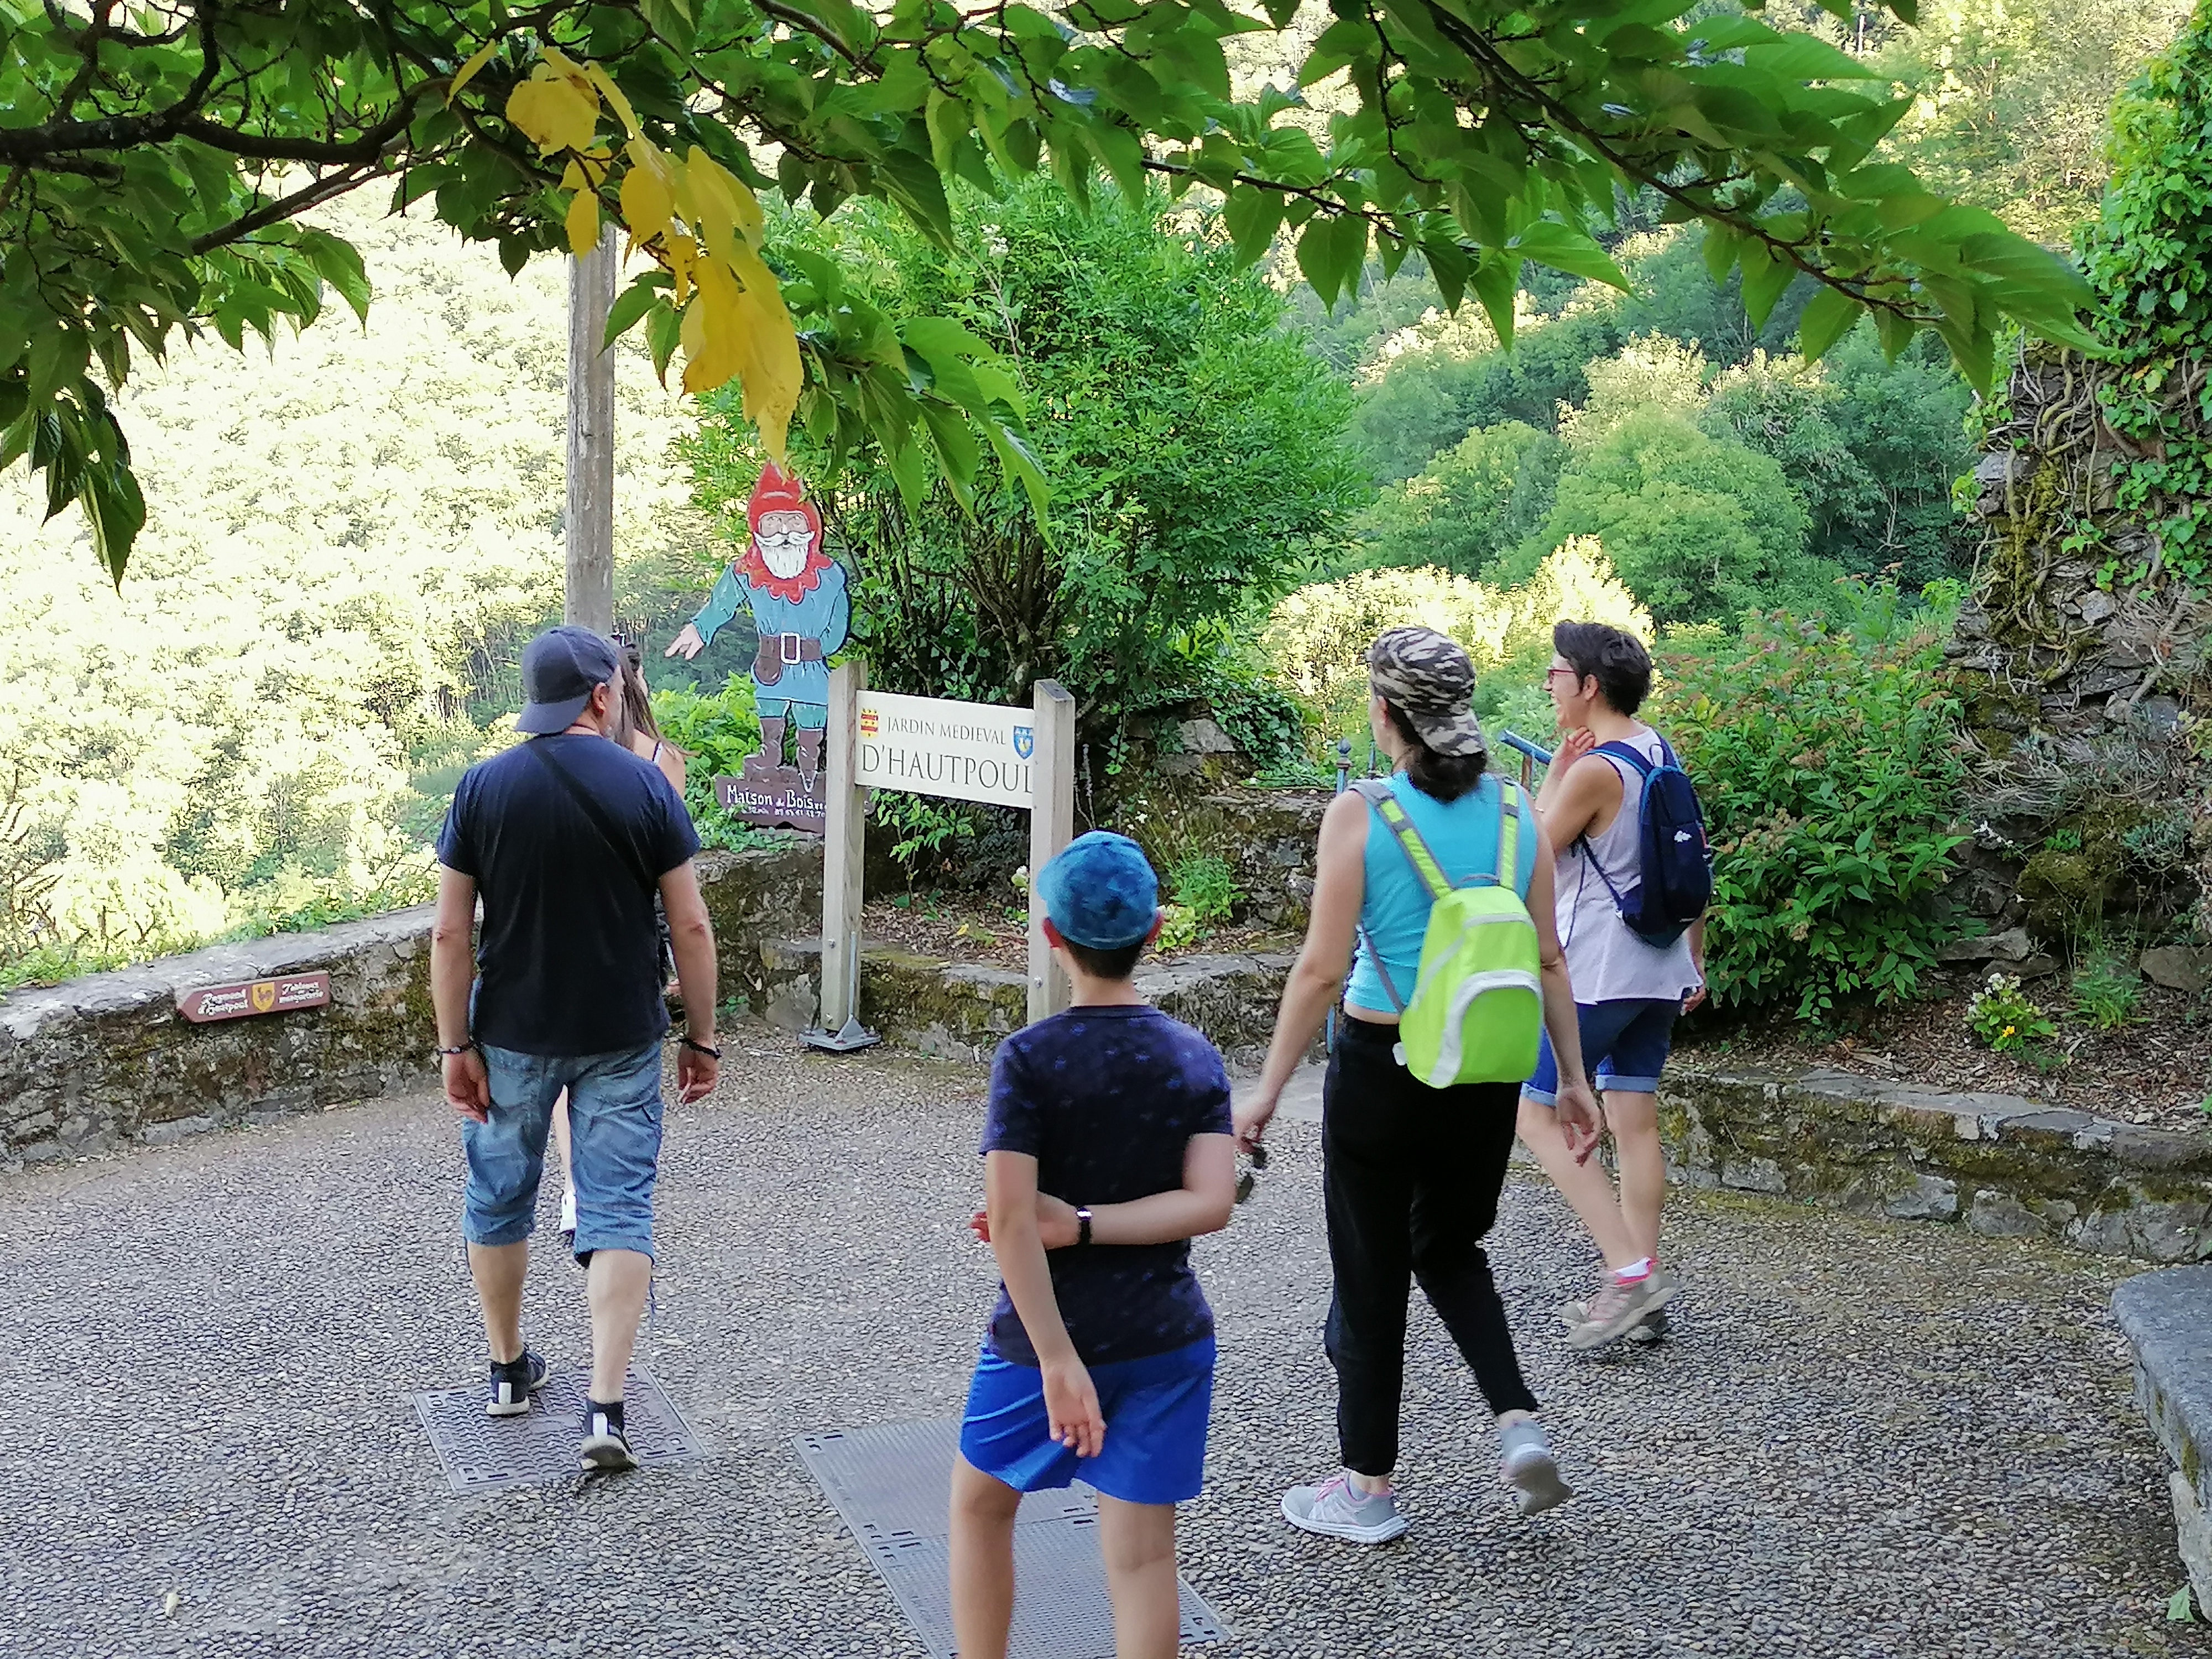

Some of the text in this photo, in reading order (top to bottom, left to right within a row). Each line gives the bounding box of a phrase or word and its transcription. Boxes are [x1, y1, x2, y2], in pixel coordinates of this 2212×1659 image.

[888, 717, 1006, 745] JARDIN MEDIEVAL
[862, 743, 1032, 794] D'HAUTPOUL
[727, 783, 773, 806] Maison
[785, 789, 815, 810] Bois
